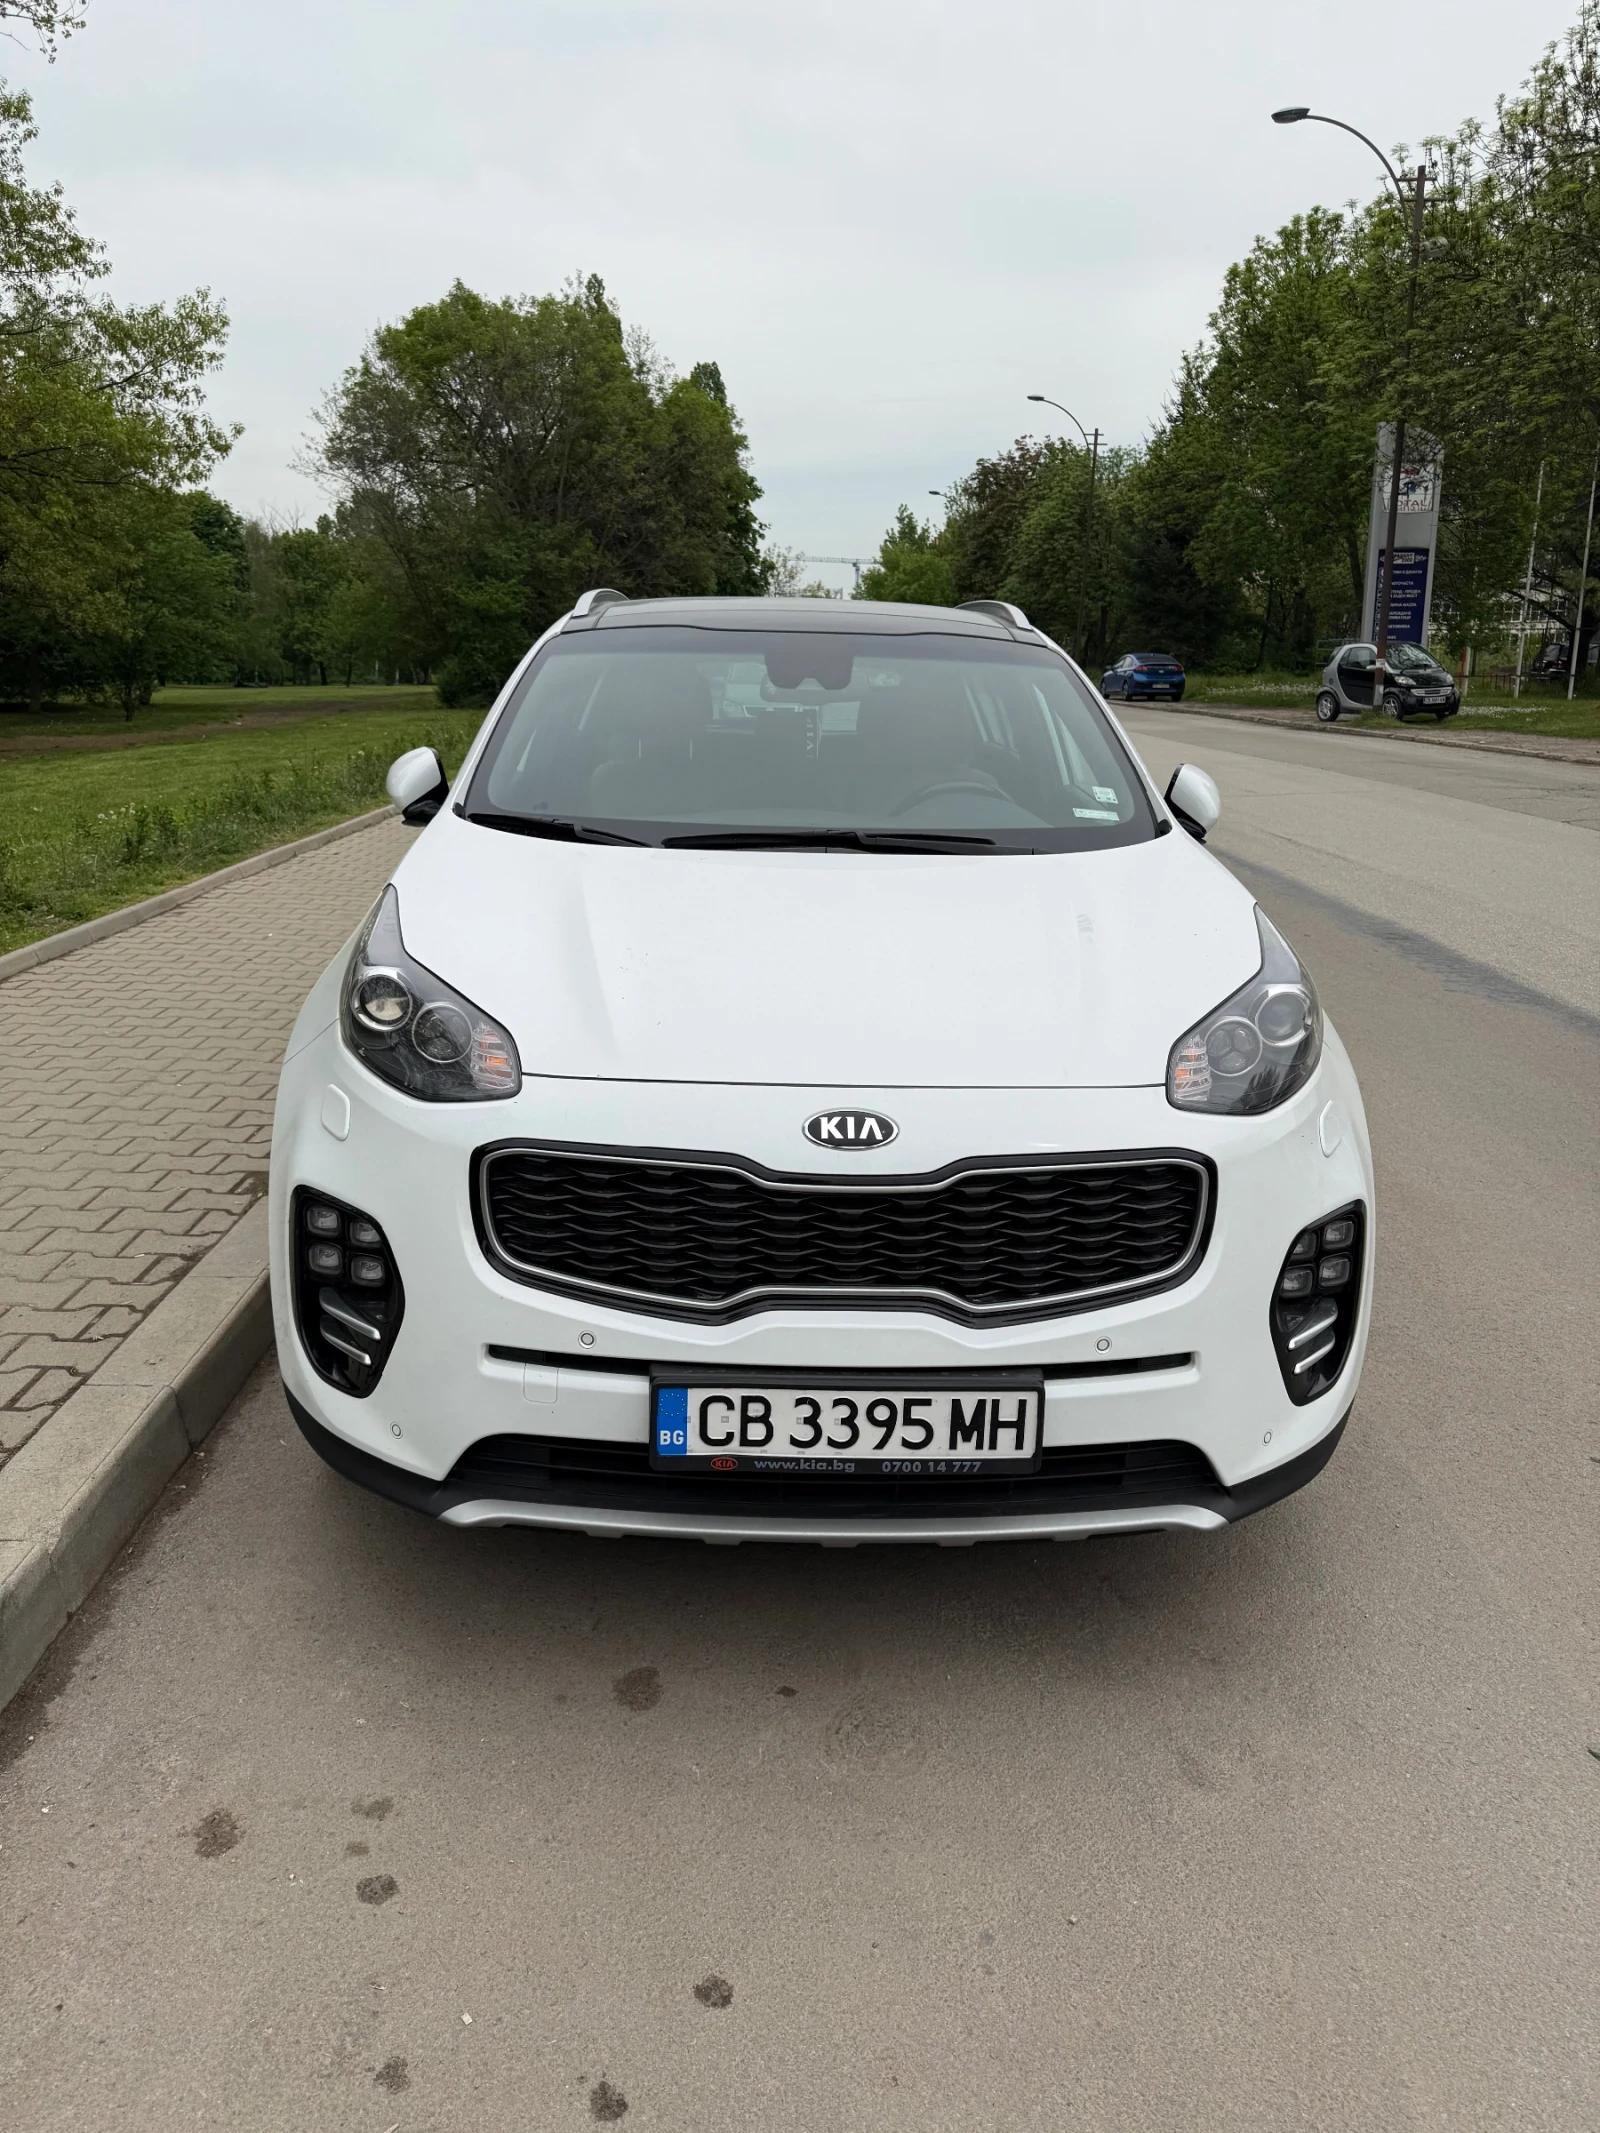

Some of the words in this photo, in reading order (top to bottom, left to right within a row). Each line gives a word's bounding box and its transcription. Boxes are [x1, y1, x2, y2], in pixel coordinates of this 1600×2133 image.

[819, 1116, 883, 1140] KIA
[699, 1394, 774, 1447] CB
[789, 1396, 935, 1450] 3395
[948, 1398, 1028, 1451] MH
[659, 1429, 685, 1446] BG
[713, 1458, 735, 1468] KIA
[754, 1460, 855, 1474] www.kia.bg
[882, 1461, 922, 1473] 0700
[928, 1461, 947, 1473] 14
[952, 1461, 982, 1473] 777
